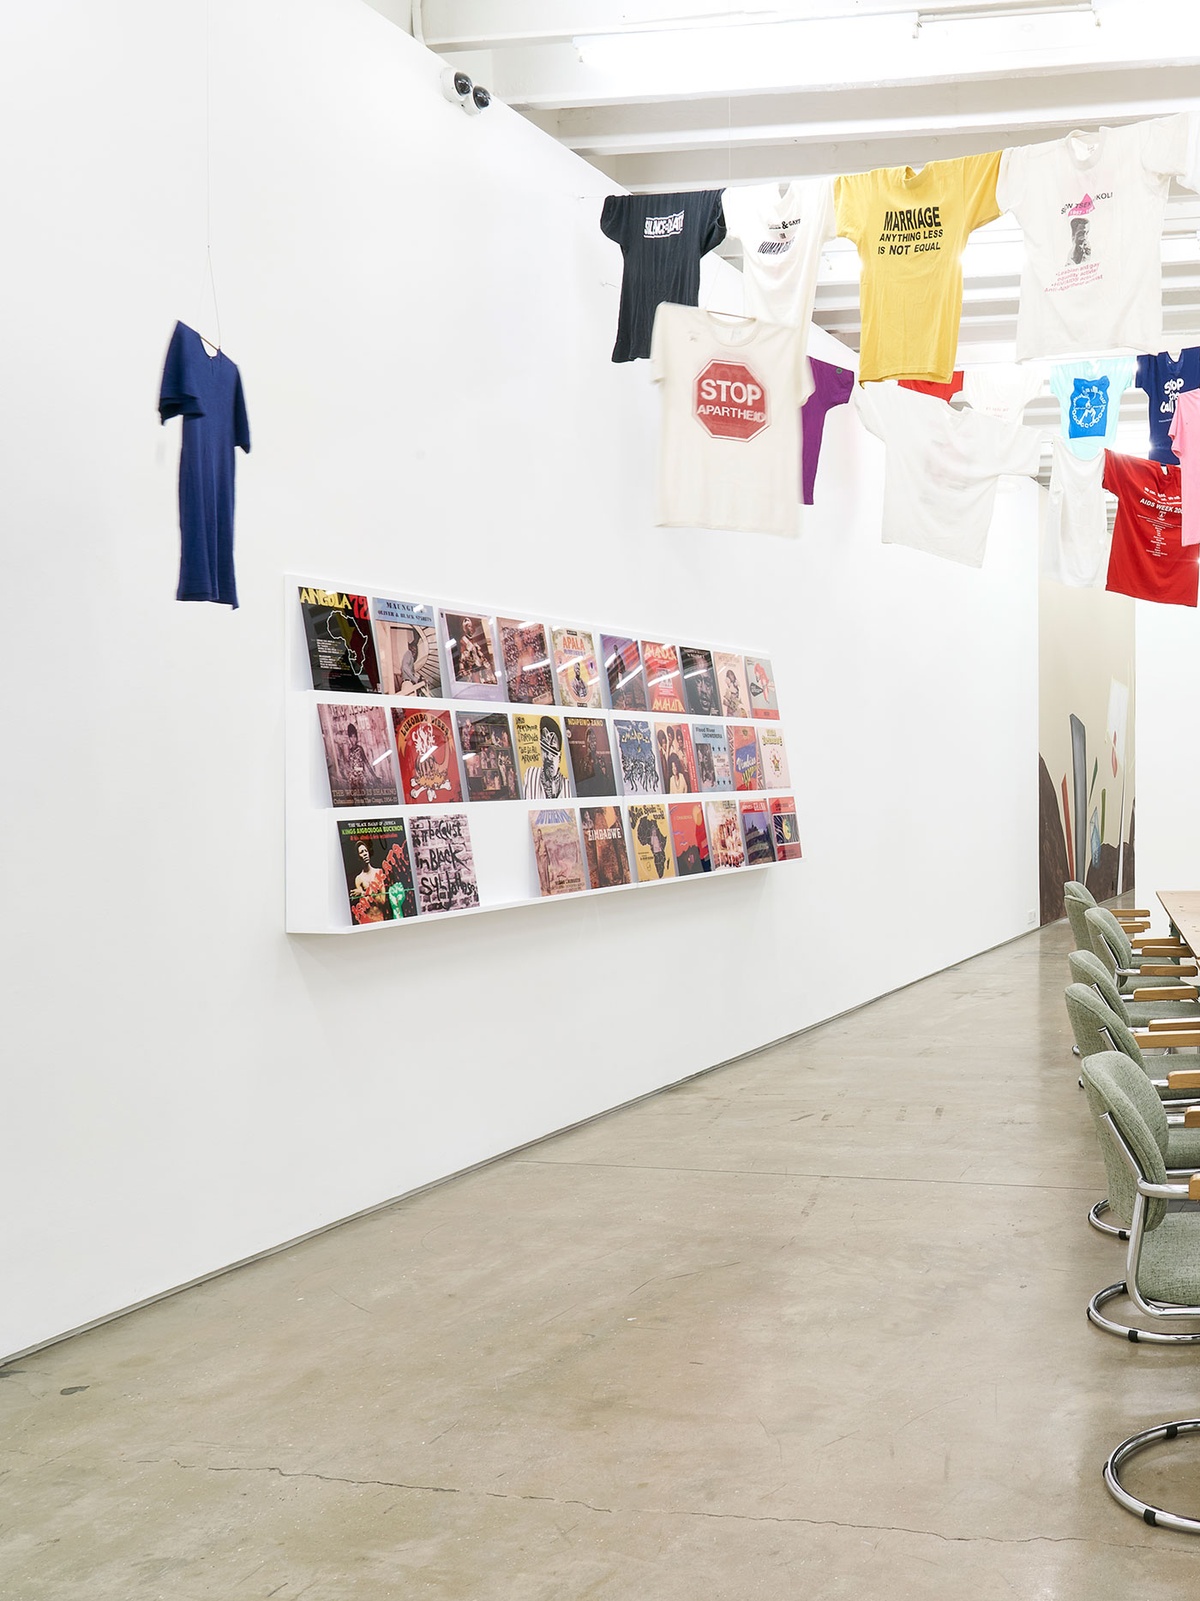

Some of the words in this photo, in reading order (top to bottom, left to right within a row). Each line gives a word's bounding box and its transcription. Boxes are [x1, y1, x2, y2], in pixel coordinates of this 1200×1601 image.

[883, 206, 941, 231] MARRIAGE
[879, 231, 921, 242] ANYTHING
[923, 229, 943, 239] LESS
[878, 246, 886, 255] IS
[889, 245, 911, 255] NOT
[914, 242, 941, 252] EQUAL
[700, 378, 763, 406] STOP
[697, 404, 767, 423] APARTHEID
[1140, 498, 1156, 508] AIDS
[1156, 504, 1174, 513] WEEK
[301, 588, 352, 610] ANGOLA
[562, 636, 585, 651] APALA
